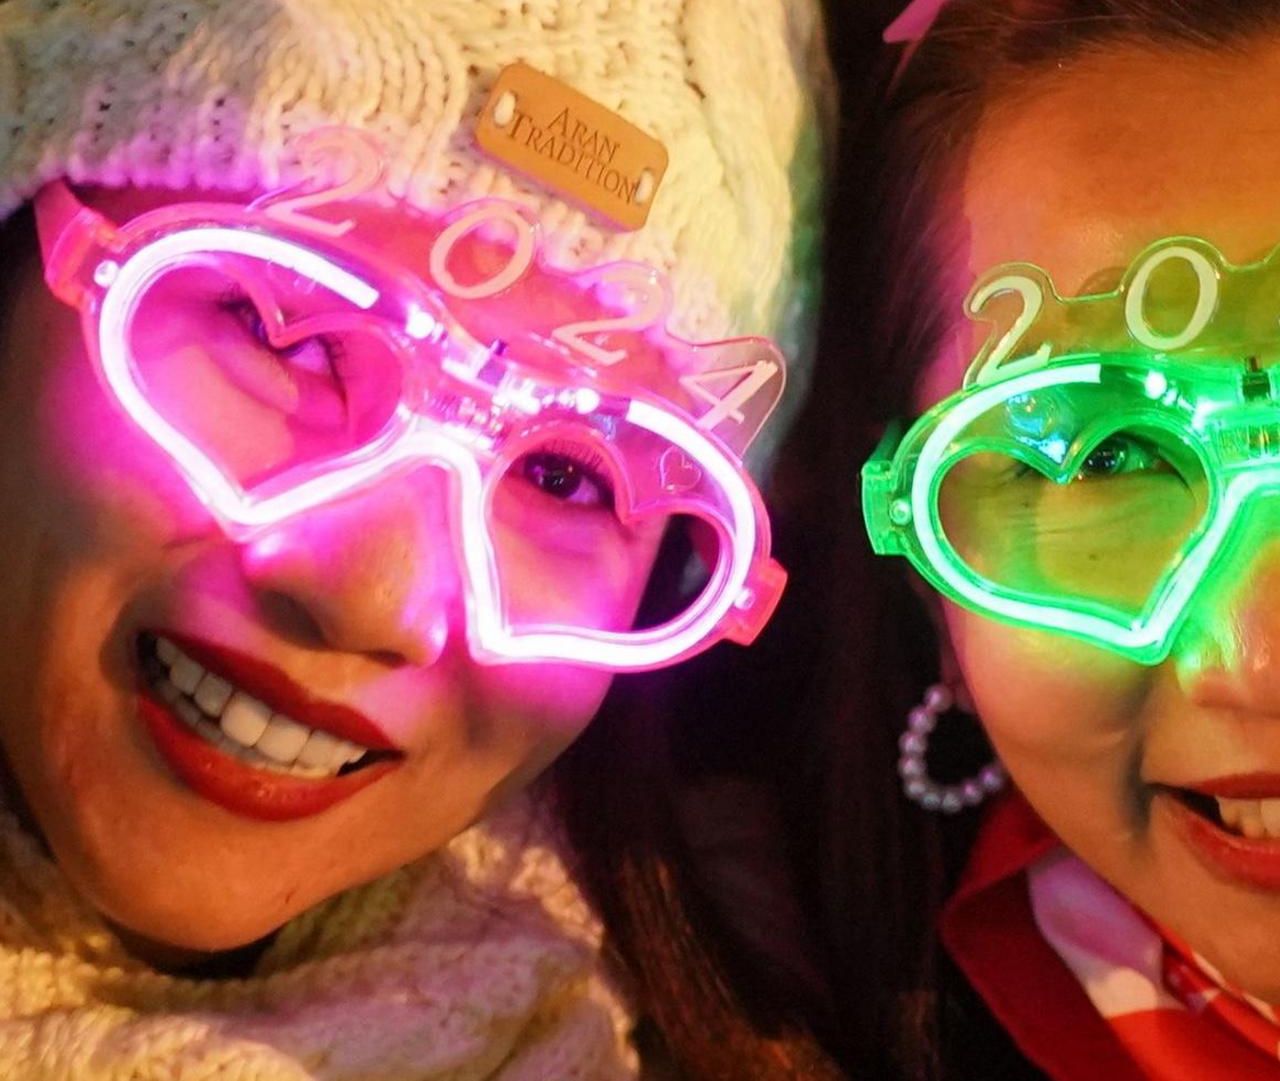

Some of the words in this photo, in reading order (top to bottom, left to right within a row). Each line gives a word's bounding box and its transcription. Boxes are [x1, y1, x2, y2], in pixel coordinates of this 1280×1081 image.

[509, 113, 639, 204] TRADITION
[548, 106, 620, 163] ARAN
[267, 131, 778, 429] 2024
